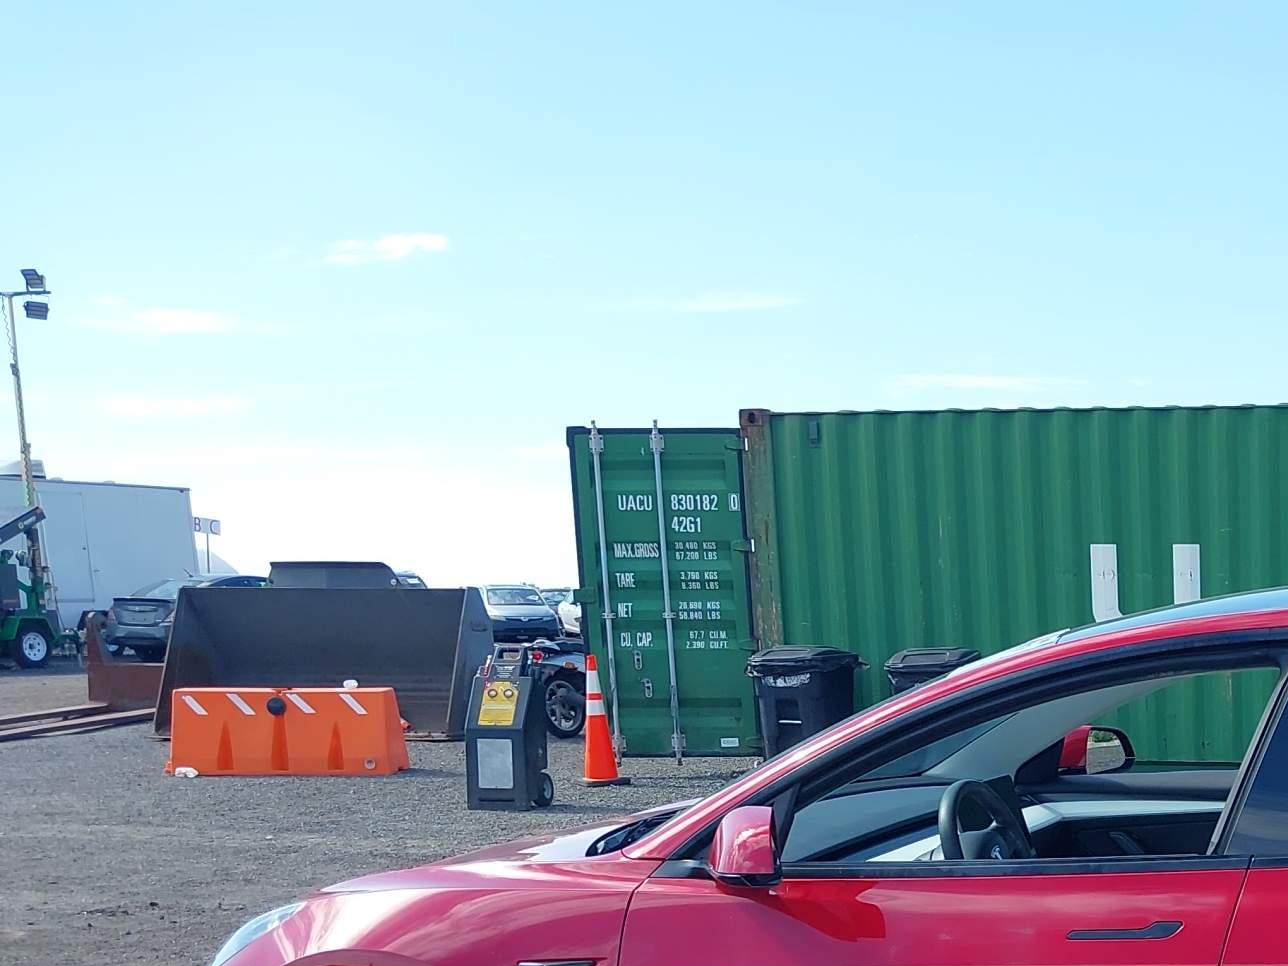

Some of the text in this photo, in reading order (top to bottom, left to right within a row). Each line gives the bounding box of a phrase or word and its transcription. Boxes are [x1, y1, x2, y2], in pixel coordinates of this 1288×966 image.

[617, 493, 739, 511] UACU 830182 0
[671, 516, 702, 533] 42G1
[613, 543, 660, 558] MAX.GROSS
[702, 541, 717, 550] KGS
[703, 551, 718, 560] LBS
[615, 572, 636, 588] TARE
[704, 571, 718, 580] KGS
[705, 581, 720, 590] LBS
[617, 602, 633, 618] NET
[706, 601, 720, 609] KGS
[707, 611, 721, 620] LBS
[620, 632, 633, 647] CU.
[636, 632, 653, 647] CAP.
